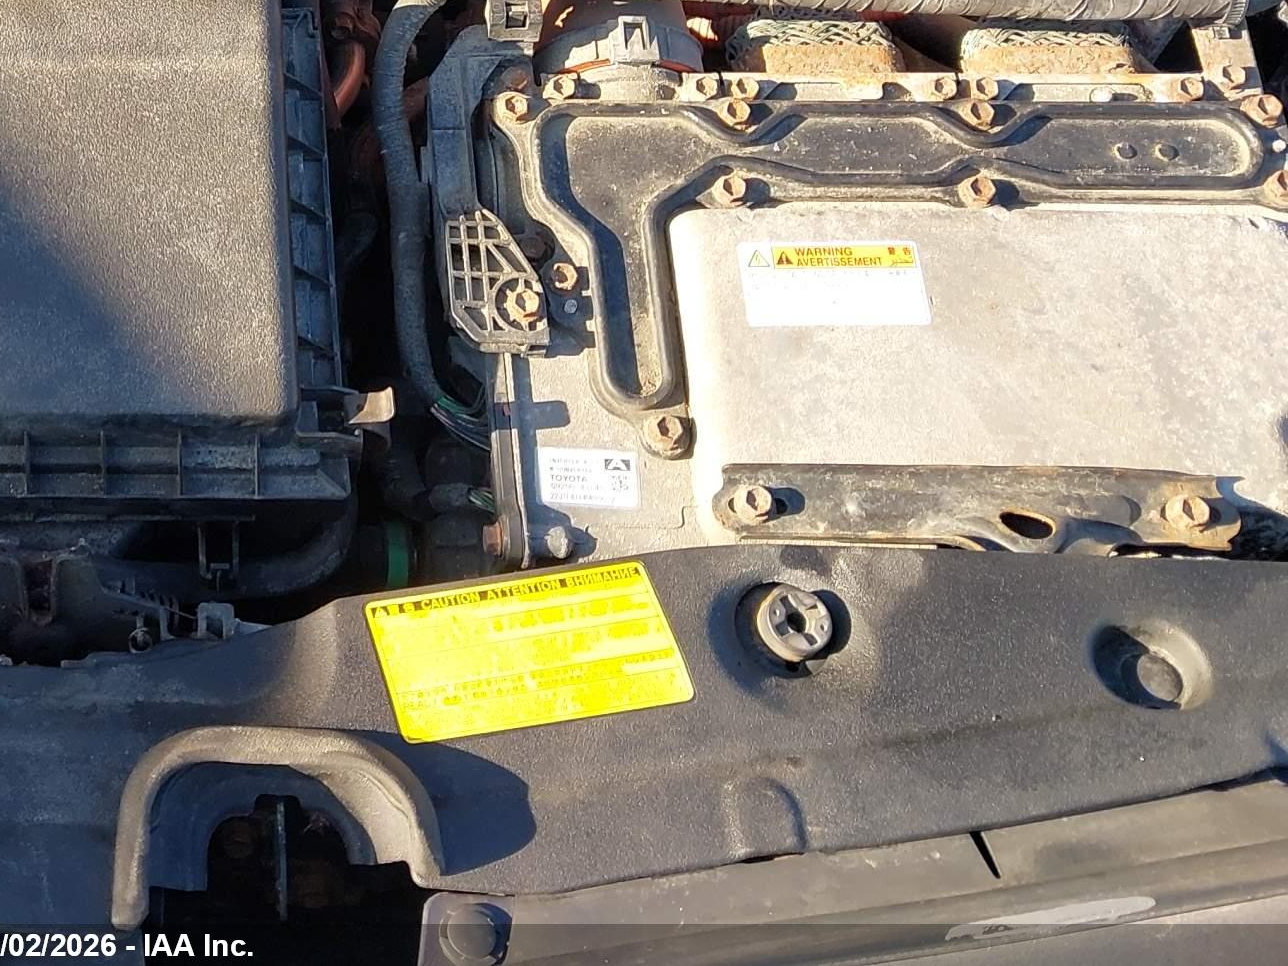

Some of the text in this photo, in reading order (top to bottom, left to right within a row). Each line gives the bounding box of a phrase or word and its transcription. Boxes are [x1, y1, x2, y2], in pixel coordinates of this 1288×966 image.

[794, 247, 853, 257] WARNING
[796, 256, 883, 267] AVERTISSEMENT
[550, 474, 589, 483] TOYOTA
[421, 591, 480, 612] CAUTION
[487, 580, 560, 601] ATTENTION
[567, 567, 639, 587] ВНИМАНИЕ
